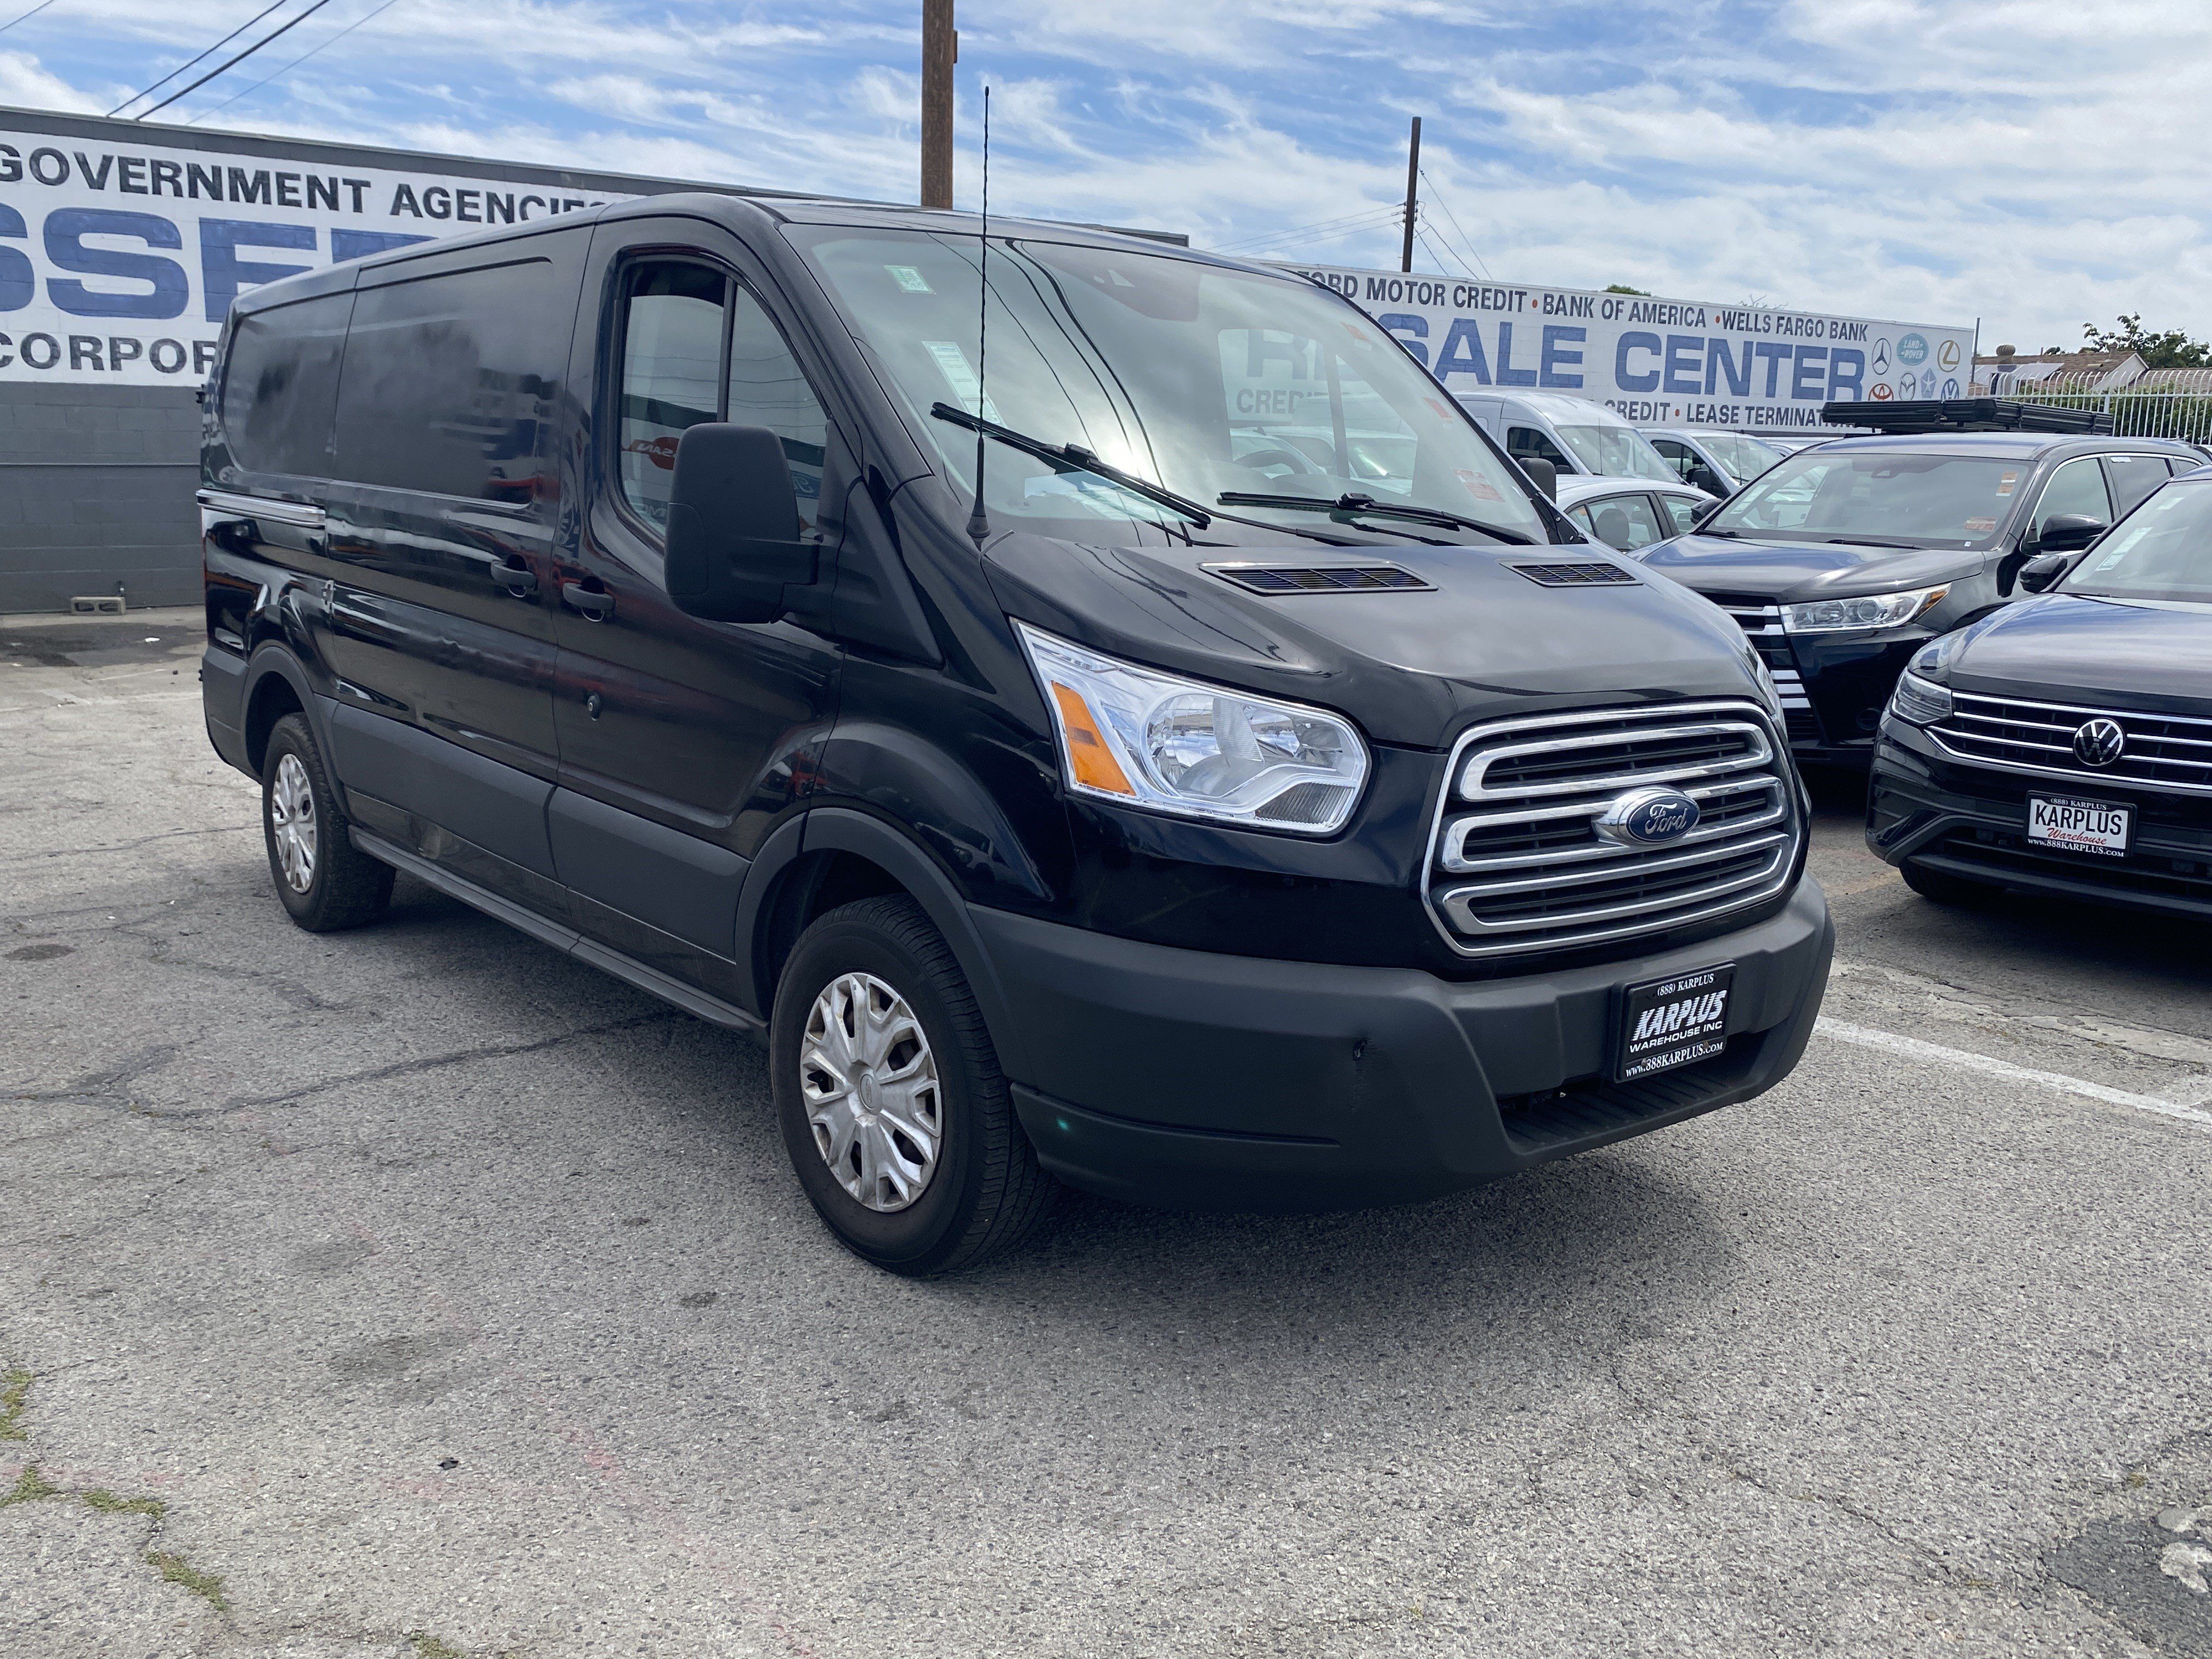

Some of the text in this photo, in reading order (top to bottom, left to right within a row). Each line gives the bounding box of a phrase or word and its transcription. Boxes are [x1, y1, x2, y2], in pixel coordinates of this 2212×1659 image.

[1366, 277, 1446, 306] MOTOR
[1453, 285, 1527, 313] CREDIT
[1543, 293, 1594, 319] BANK
[1601, 298, 1625, 320] OF
[1628, 302, 1707, 328] AMERICA
[1722, 310, 1771, 334] WELLS
[1776, 315, 1825, 338] FARGO
[1829, 321, 1868, 341] BANK
[1615, 331, 1865, 402] CENTER
[1686, 403, 1740, 425] LEASE
[1645, 802, 1688, 835] Ford
[2035, 804, 2123, 836] KARPLUS
[2070, 800, 2107, 811] KARPLUS
[2046, 827, 2107, 845] Warehouse
[1657, 973, 1714, 997] (888) KARPLUS
[1630, 990, 1728, 1041] KARPLUS
[1629, 1020, 1723, 1053] WAREHOUSE INC
